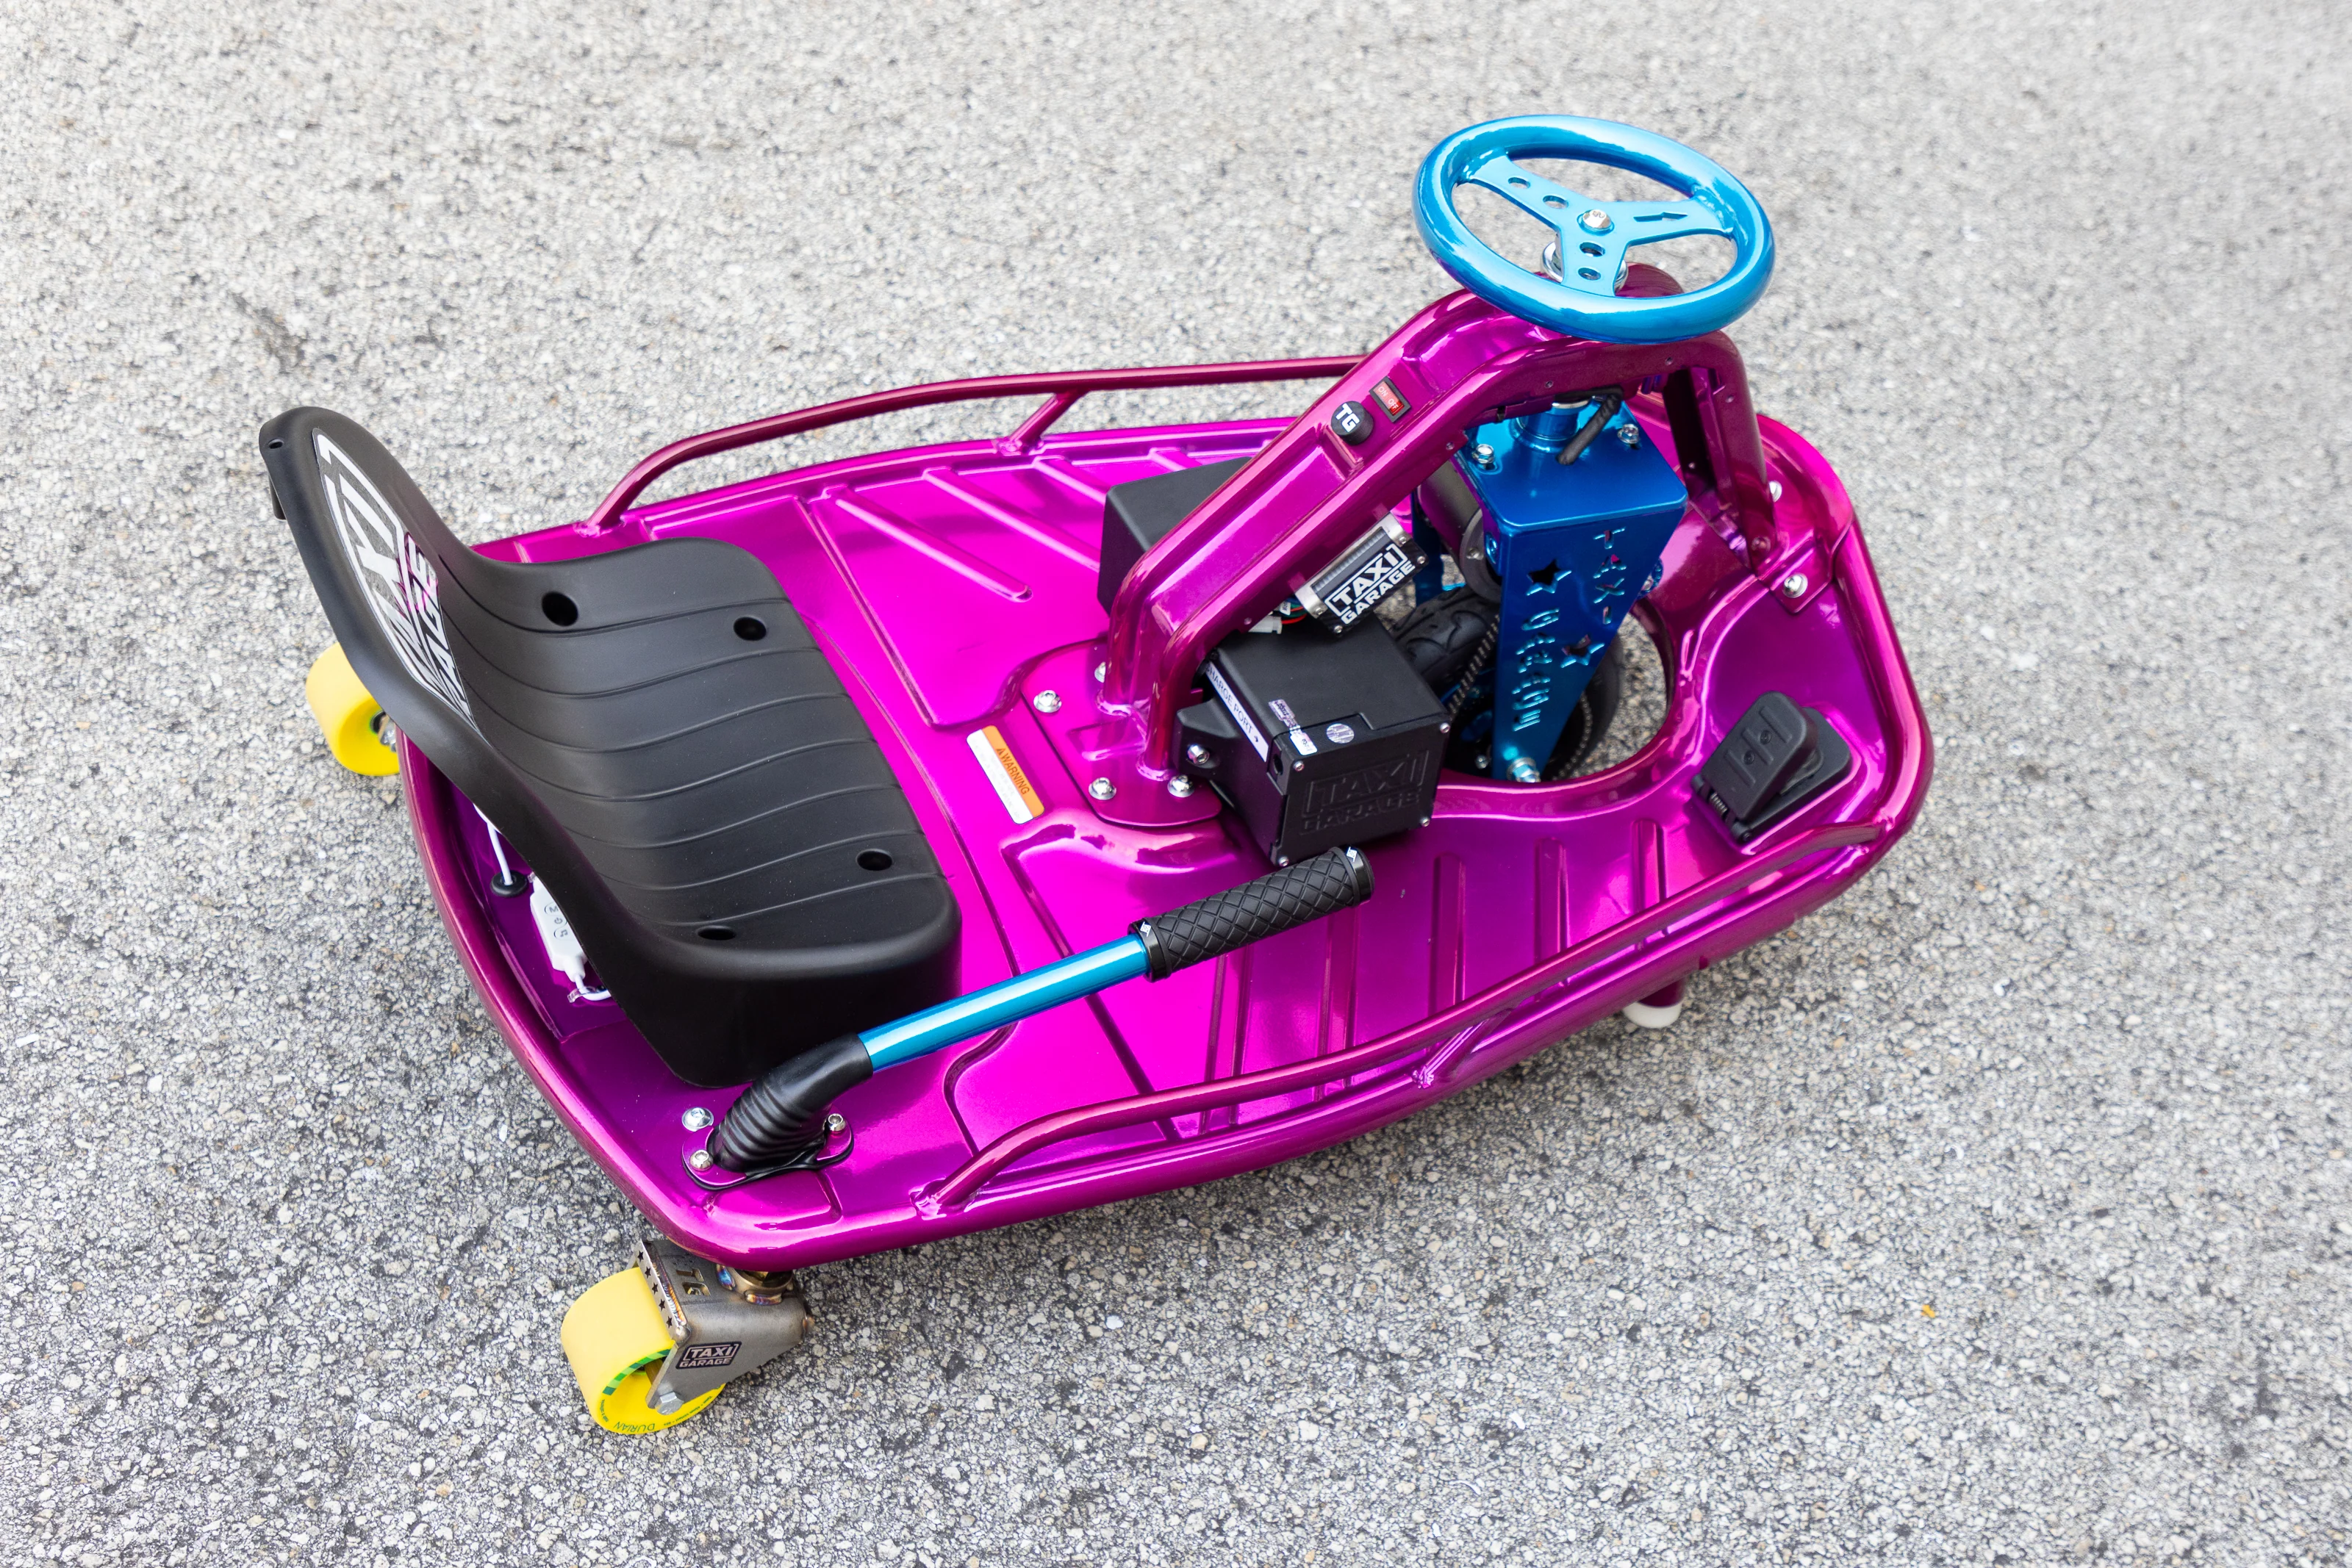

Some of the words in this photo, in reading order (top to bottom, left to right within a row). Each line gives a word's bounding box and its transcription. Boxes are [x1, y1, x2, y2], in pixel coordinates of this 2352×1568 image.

[1378, 386, 1388, 397] ON
[1388, 398, 1399, 410] OFF
[1335, 403, 1360, 433] TG
[1333, 552, 1399, 605] TAXI
[1341, 560, 1416, 625] GARAGE
[1233, 703, 1254, 733] PORT
[1000, 752, 1030, 795] WARNING
[679, 1358, 732, 1368] GARAGE
[691, 1346, 734, 1359] TAXI
[613, 1421, 656, 1433] DURIAN
